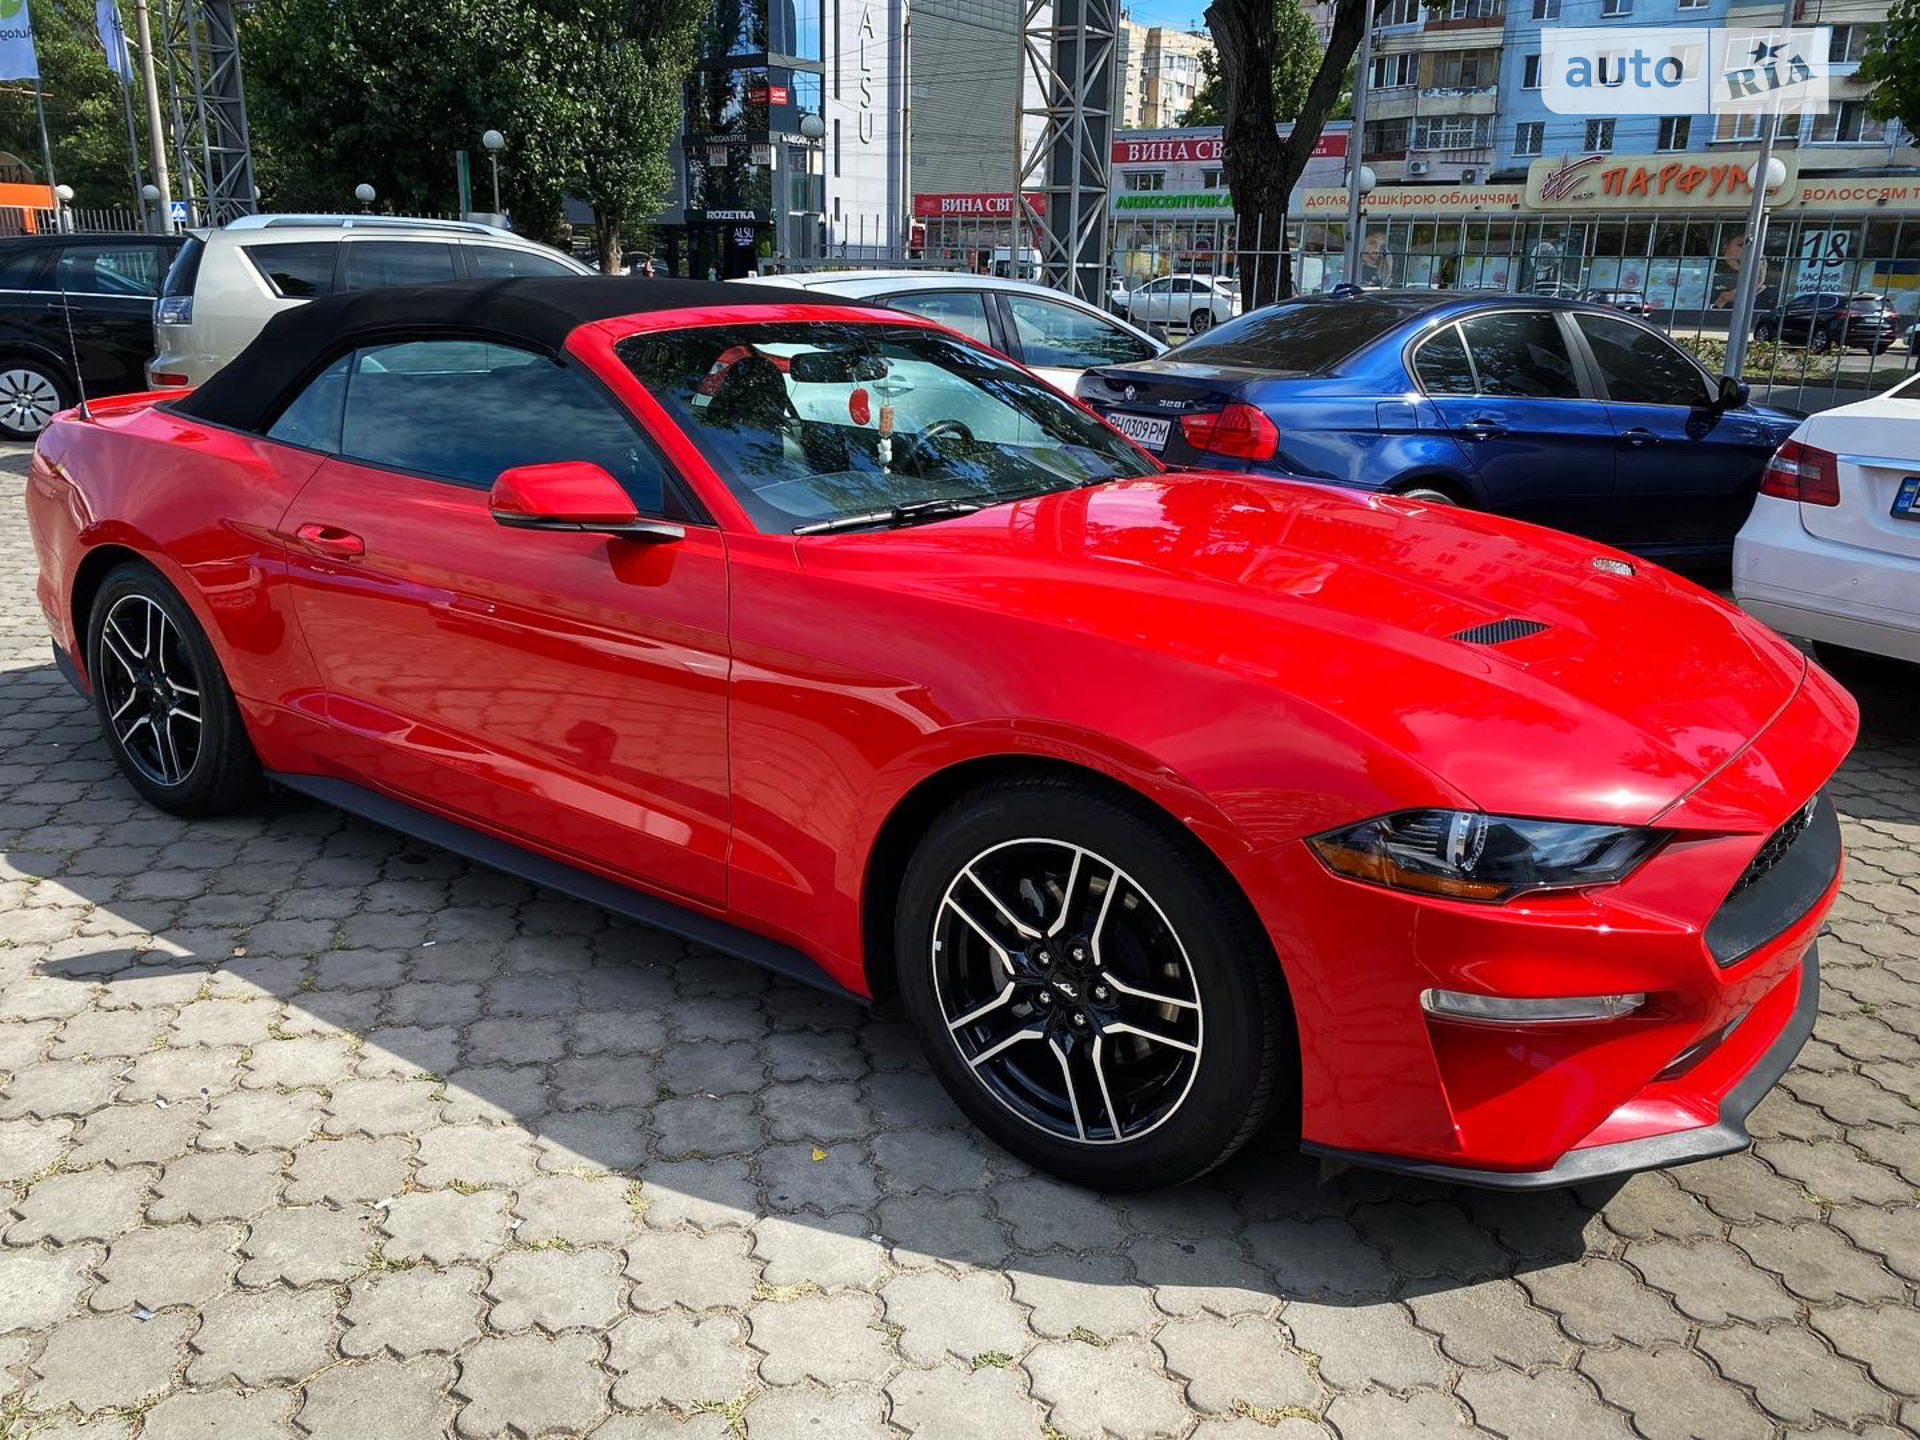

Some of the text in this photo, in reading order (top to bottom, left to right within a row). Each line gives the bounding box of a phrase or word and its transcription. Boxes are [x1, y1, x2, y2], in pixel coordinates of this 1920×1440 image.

[858, 2, 873, 144] ALSU
[1128, 142, 1190, 162] ВИНА
[1602, 162, 1778, 198] ПАРФУМ
[706, 210, 756, 219] ROZETKA
[941, 198, 984, 213] ВИНА
[734, 227, 754, 238] ALSU
[1804, 231, 1847, 268] 18
